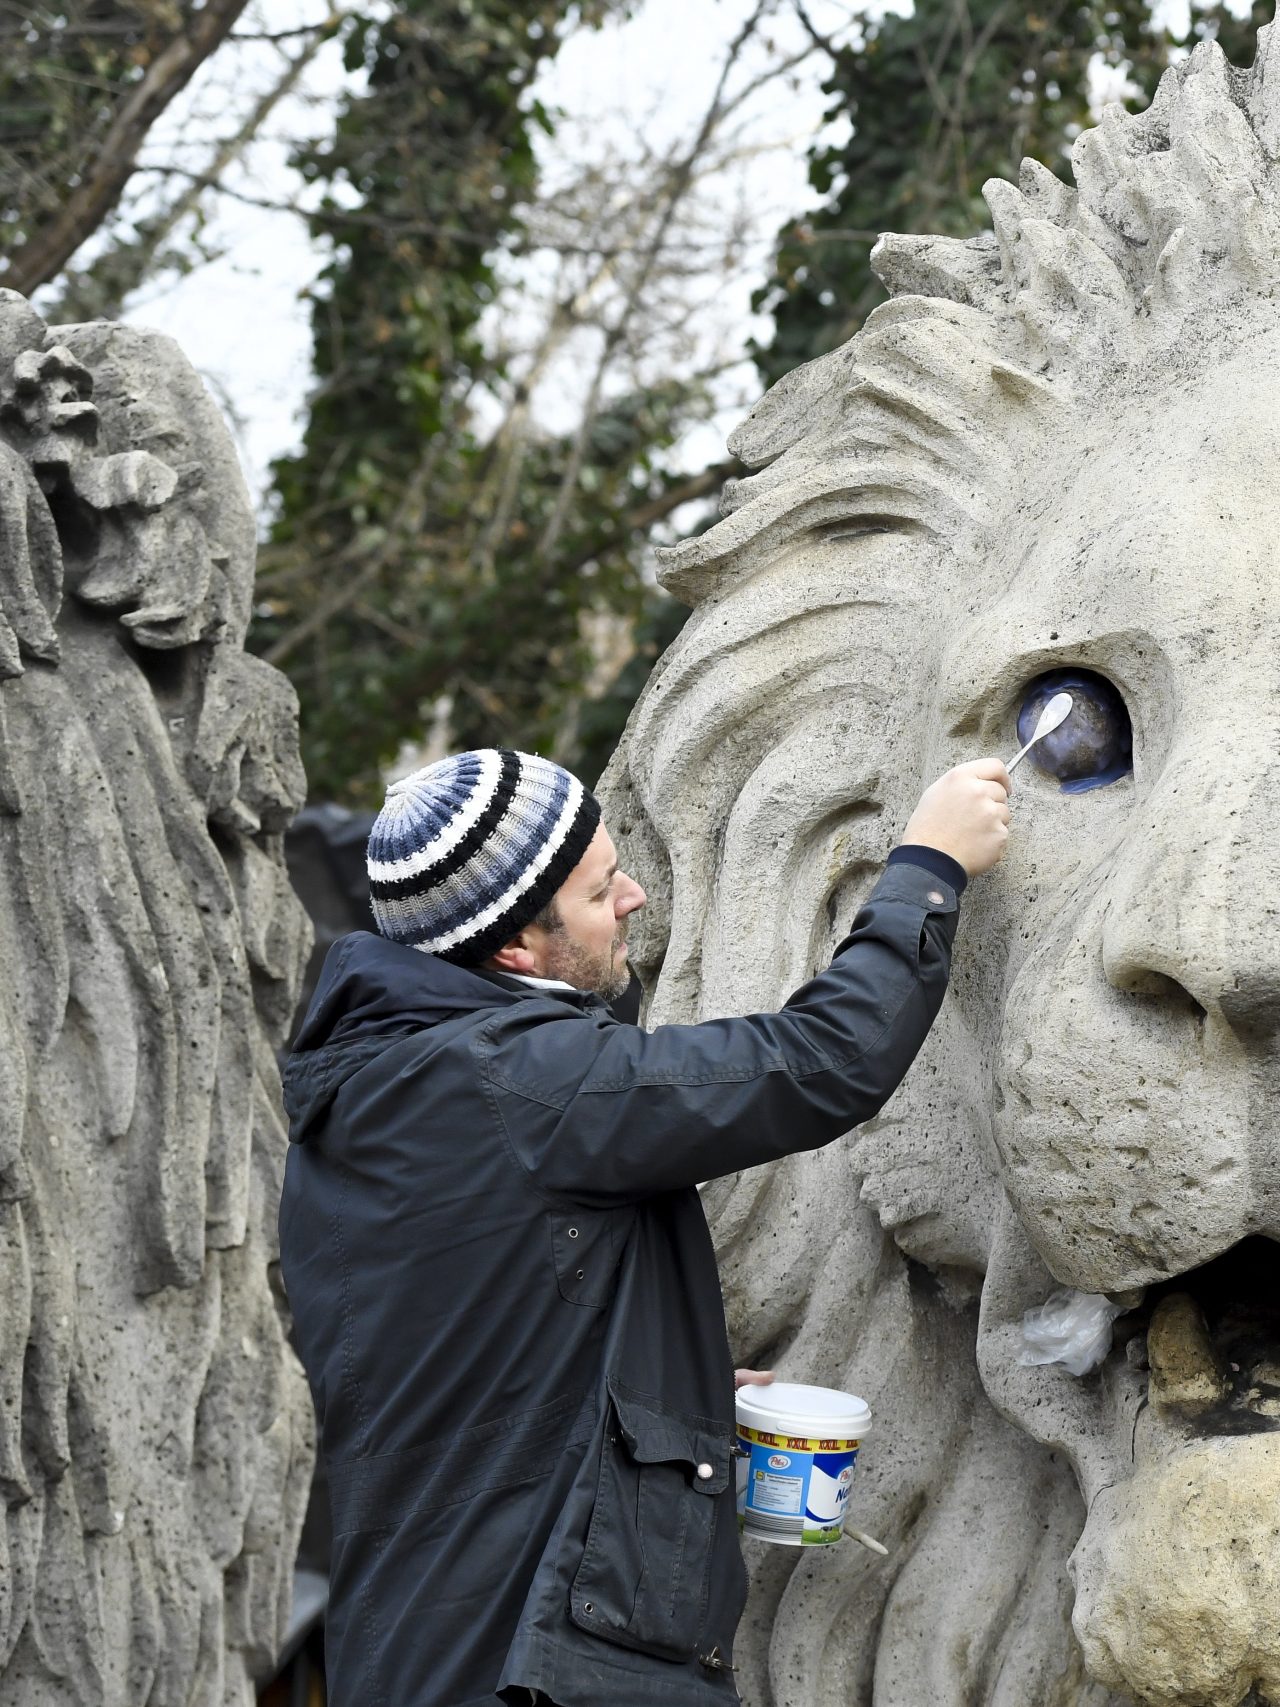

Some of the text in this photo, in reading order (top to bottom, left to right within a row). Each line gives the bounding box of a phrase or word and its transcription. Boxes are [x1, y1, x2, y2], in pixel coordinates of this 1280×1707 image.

[757, 1431, 779, 1447] XXL
[786, 1438, 812, 1451] XXL
[819, 1440, 841, 1450] XXL
